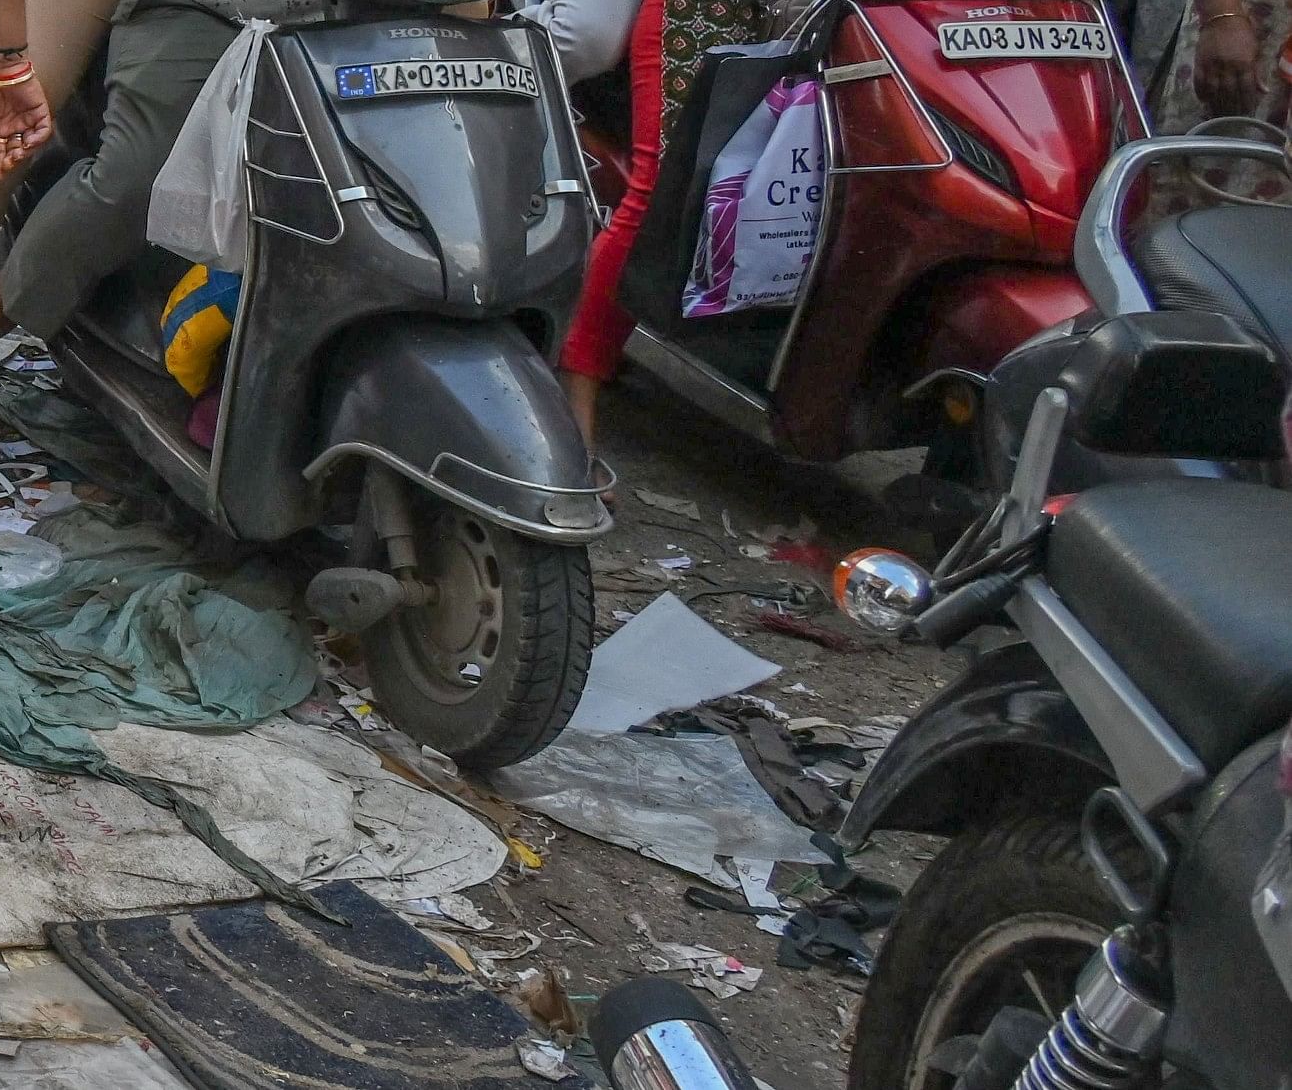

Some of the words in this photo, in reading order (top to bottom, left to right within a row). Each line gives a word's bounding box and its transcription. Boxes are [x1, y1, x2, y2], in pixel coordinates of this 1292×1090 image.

[966, 5, 1035, 20] HONDA
[387, 27, 468, 41] HONDA
[372, 66, 409, 94] KA
[494, 63, 538, 94] 1645
